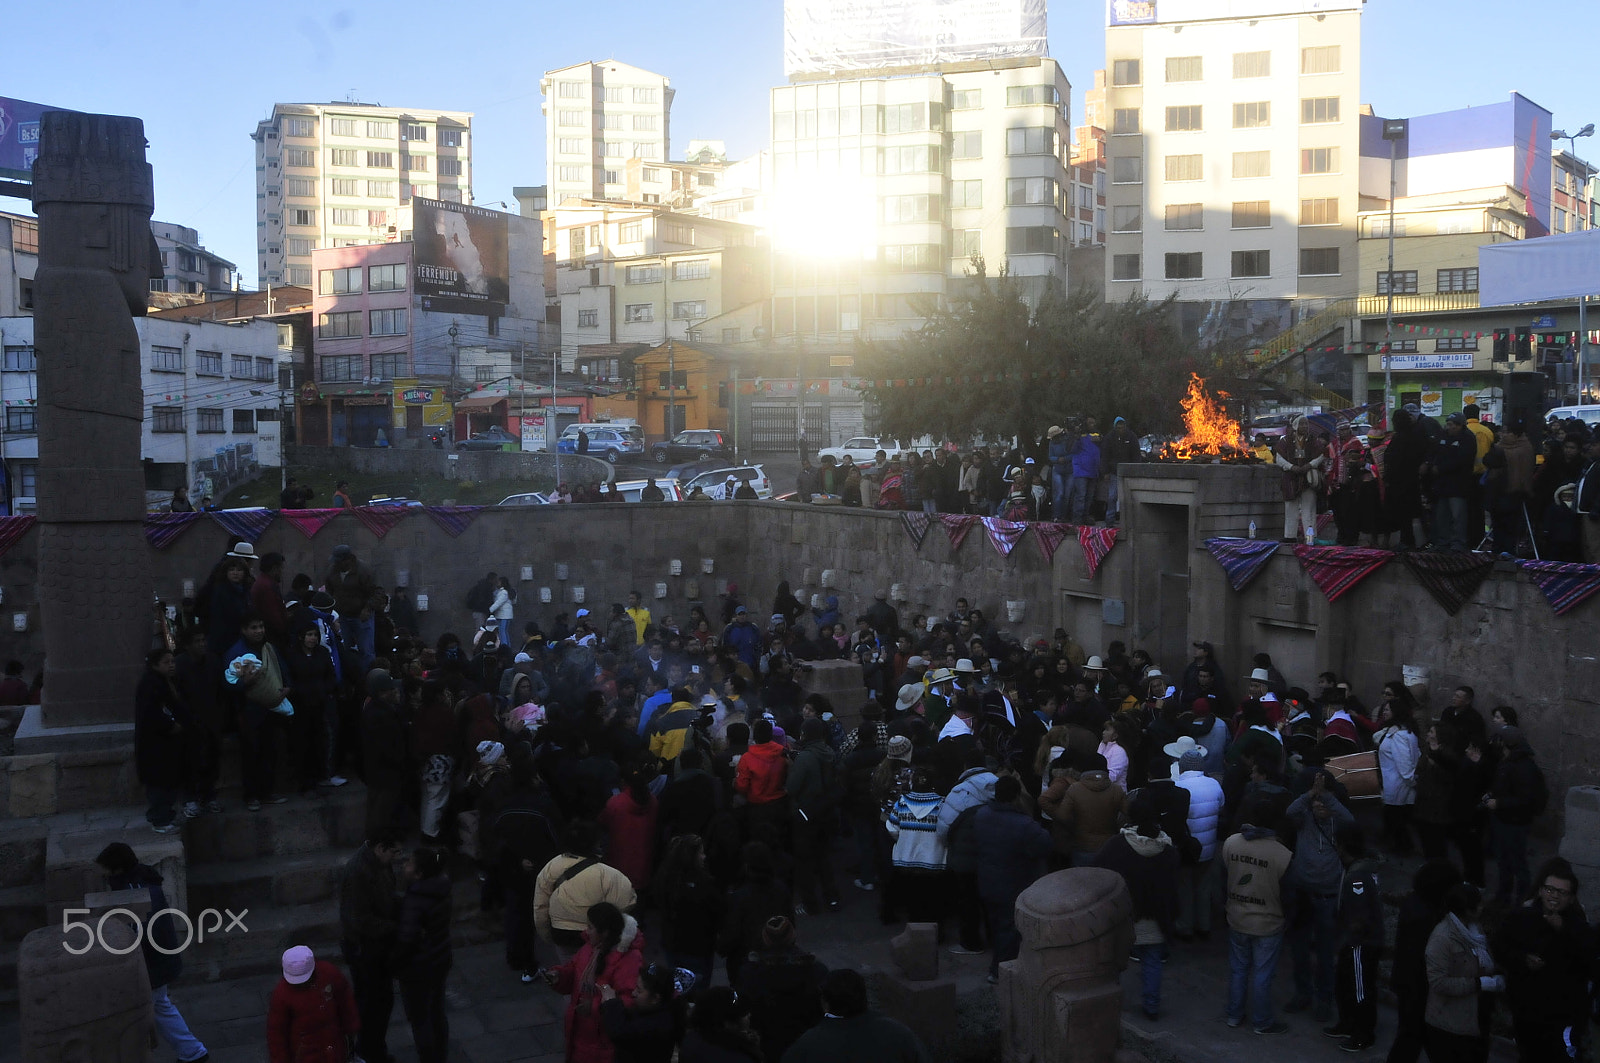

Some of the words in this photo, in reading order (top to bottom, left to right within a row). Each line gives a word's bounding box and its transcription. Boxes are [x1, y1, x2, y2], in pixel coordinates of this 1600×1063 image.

[22, 129, 30, 140] Bs
[417, 266, 458, 282] TERREMOTO
[1382, 355, 1427, 363] CNSULTORIA
[1240, 855, 1258, 866] COCA
